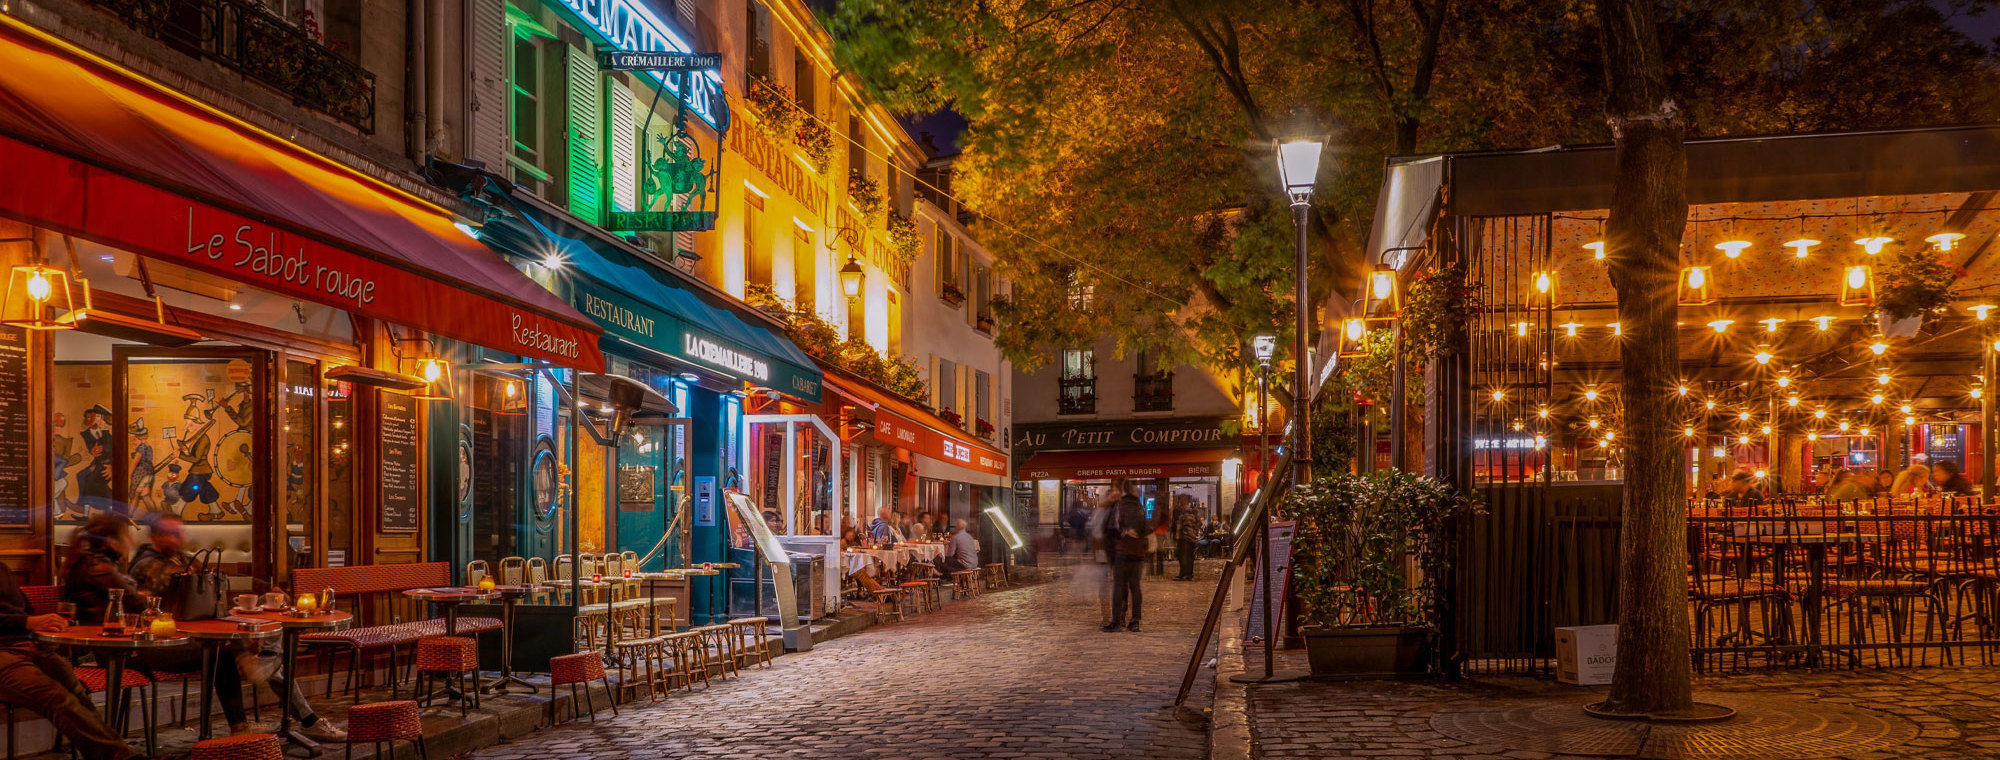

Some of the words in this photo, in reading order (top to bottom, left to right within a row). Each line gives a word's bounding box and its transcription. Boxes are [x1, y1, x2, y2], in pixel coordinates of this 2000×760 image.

[621, 54, 686, 67] CRÉMAILLÈRE
[730, 110, 829, 222] RESTAURANT
[836, 204, 867, 257] CHEZ
[188, 206, 224, 260] Le
[233, 225, 310, 286] Sabot
[315, 265, 376, 308] rouge
[511, 313, 580, 359] Restaurant
[585, 293, 655, 338] RESTAURANT
[792, 374, 817, 398] CABARET
[1030, 471, 1050, 479] PIZZA
[1105, 468, 1128, 477] PASTA
[1129, 468, 1163, 476] BURGERS
[1188, 466, 1210, 475] BIÈRE
